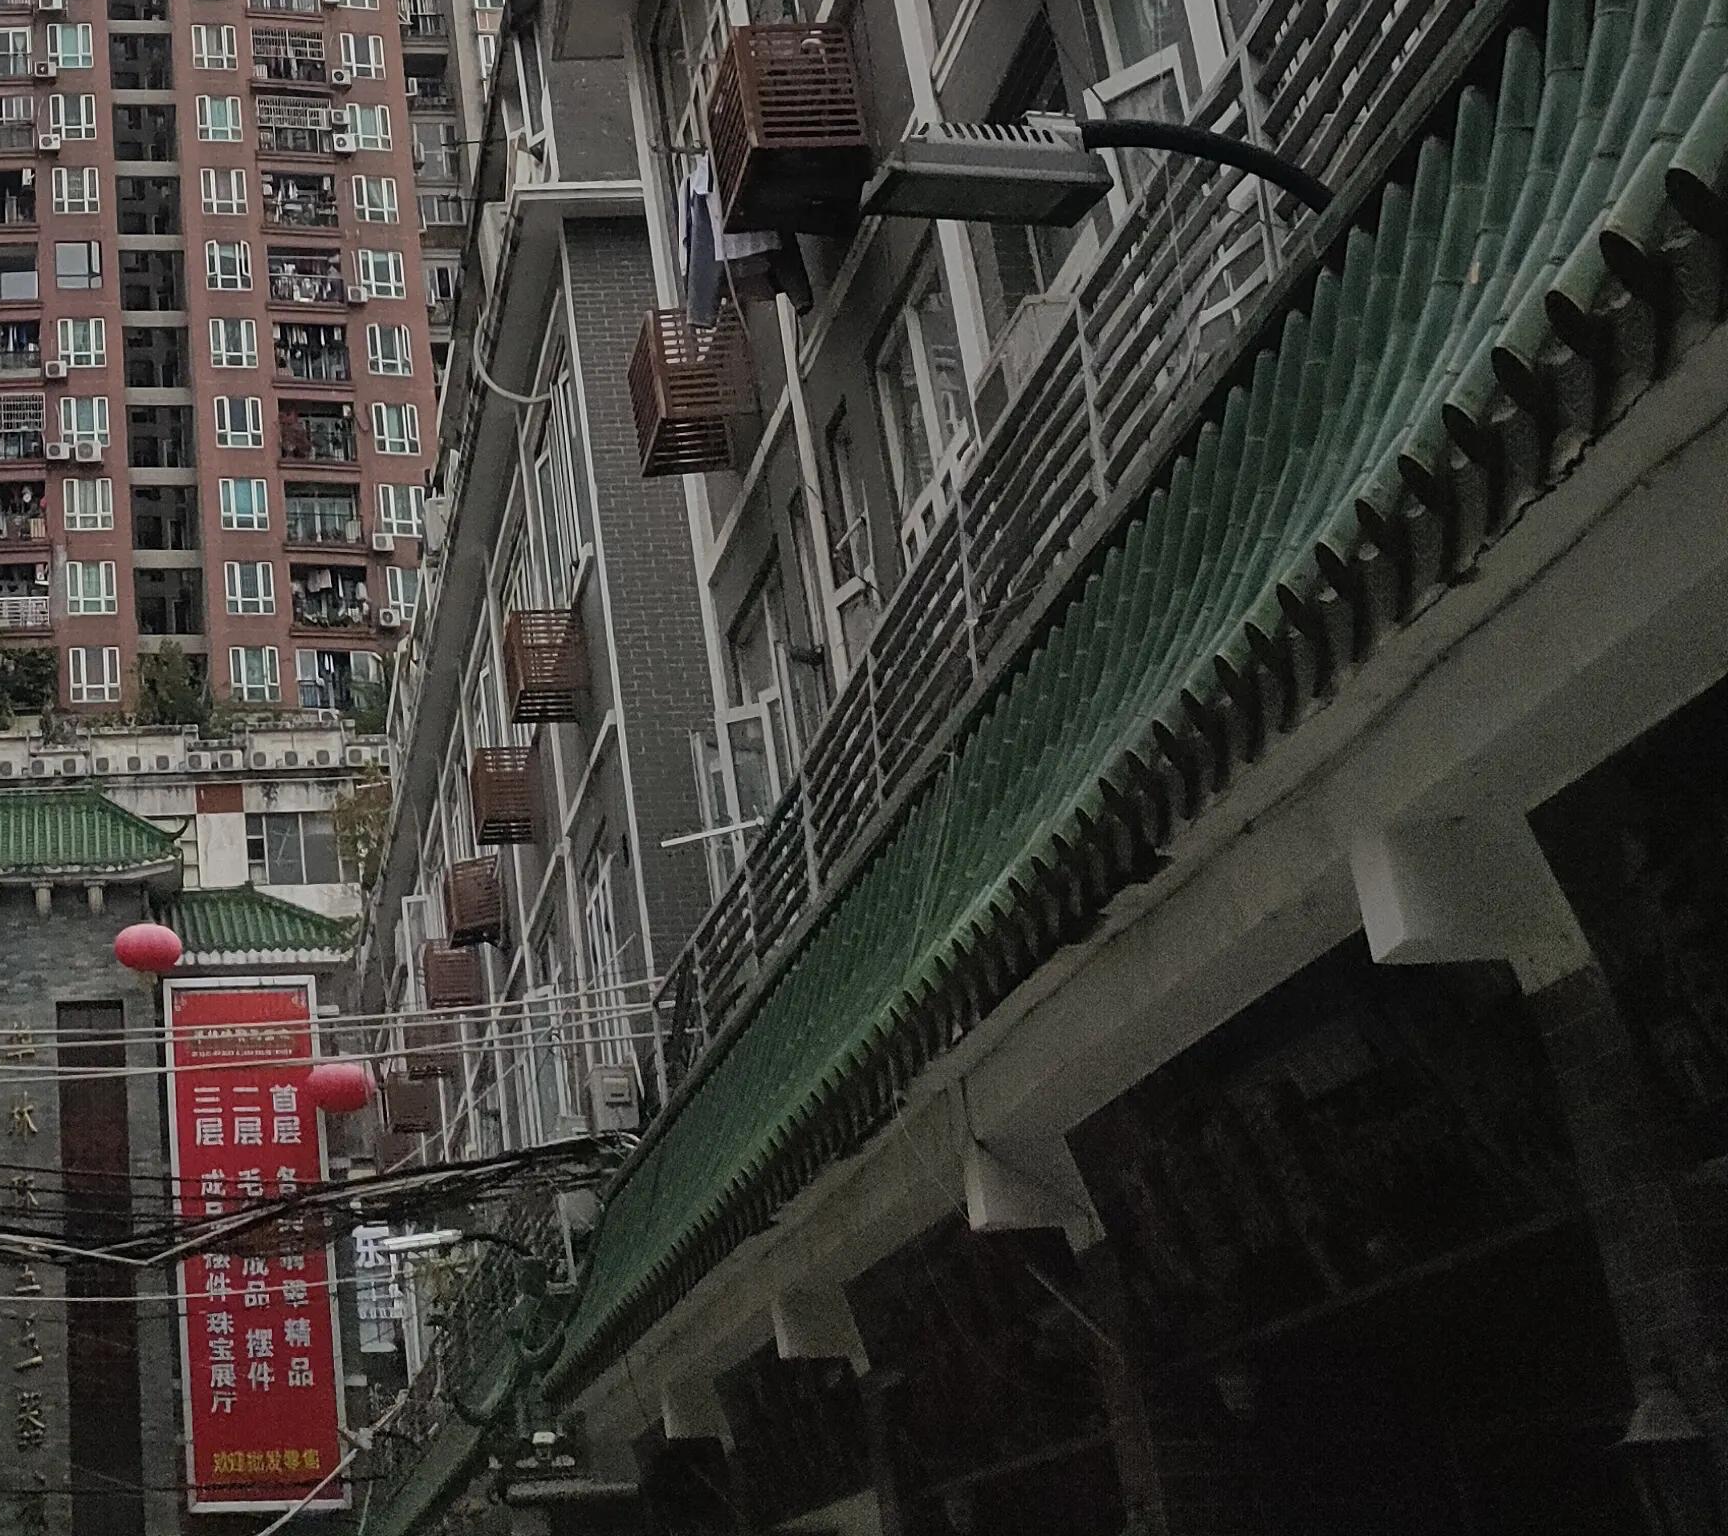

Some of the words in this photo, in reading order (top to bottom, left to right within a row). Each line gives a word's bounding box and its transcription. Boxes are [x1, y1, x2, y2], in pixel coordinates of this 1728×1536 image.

[193, 1086, 224, 1146] 三层
[232, 1086, 263, 1145] 二层
[269, 1083, 302, 1145] 首层
[207, 1311, 237, 1414] 珠宝展厅
[246, 1328, 275, 1392] 摆件
